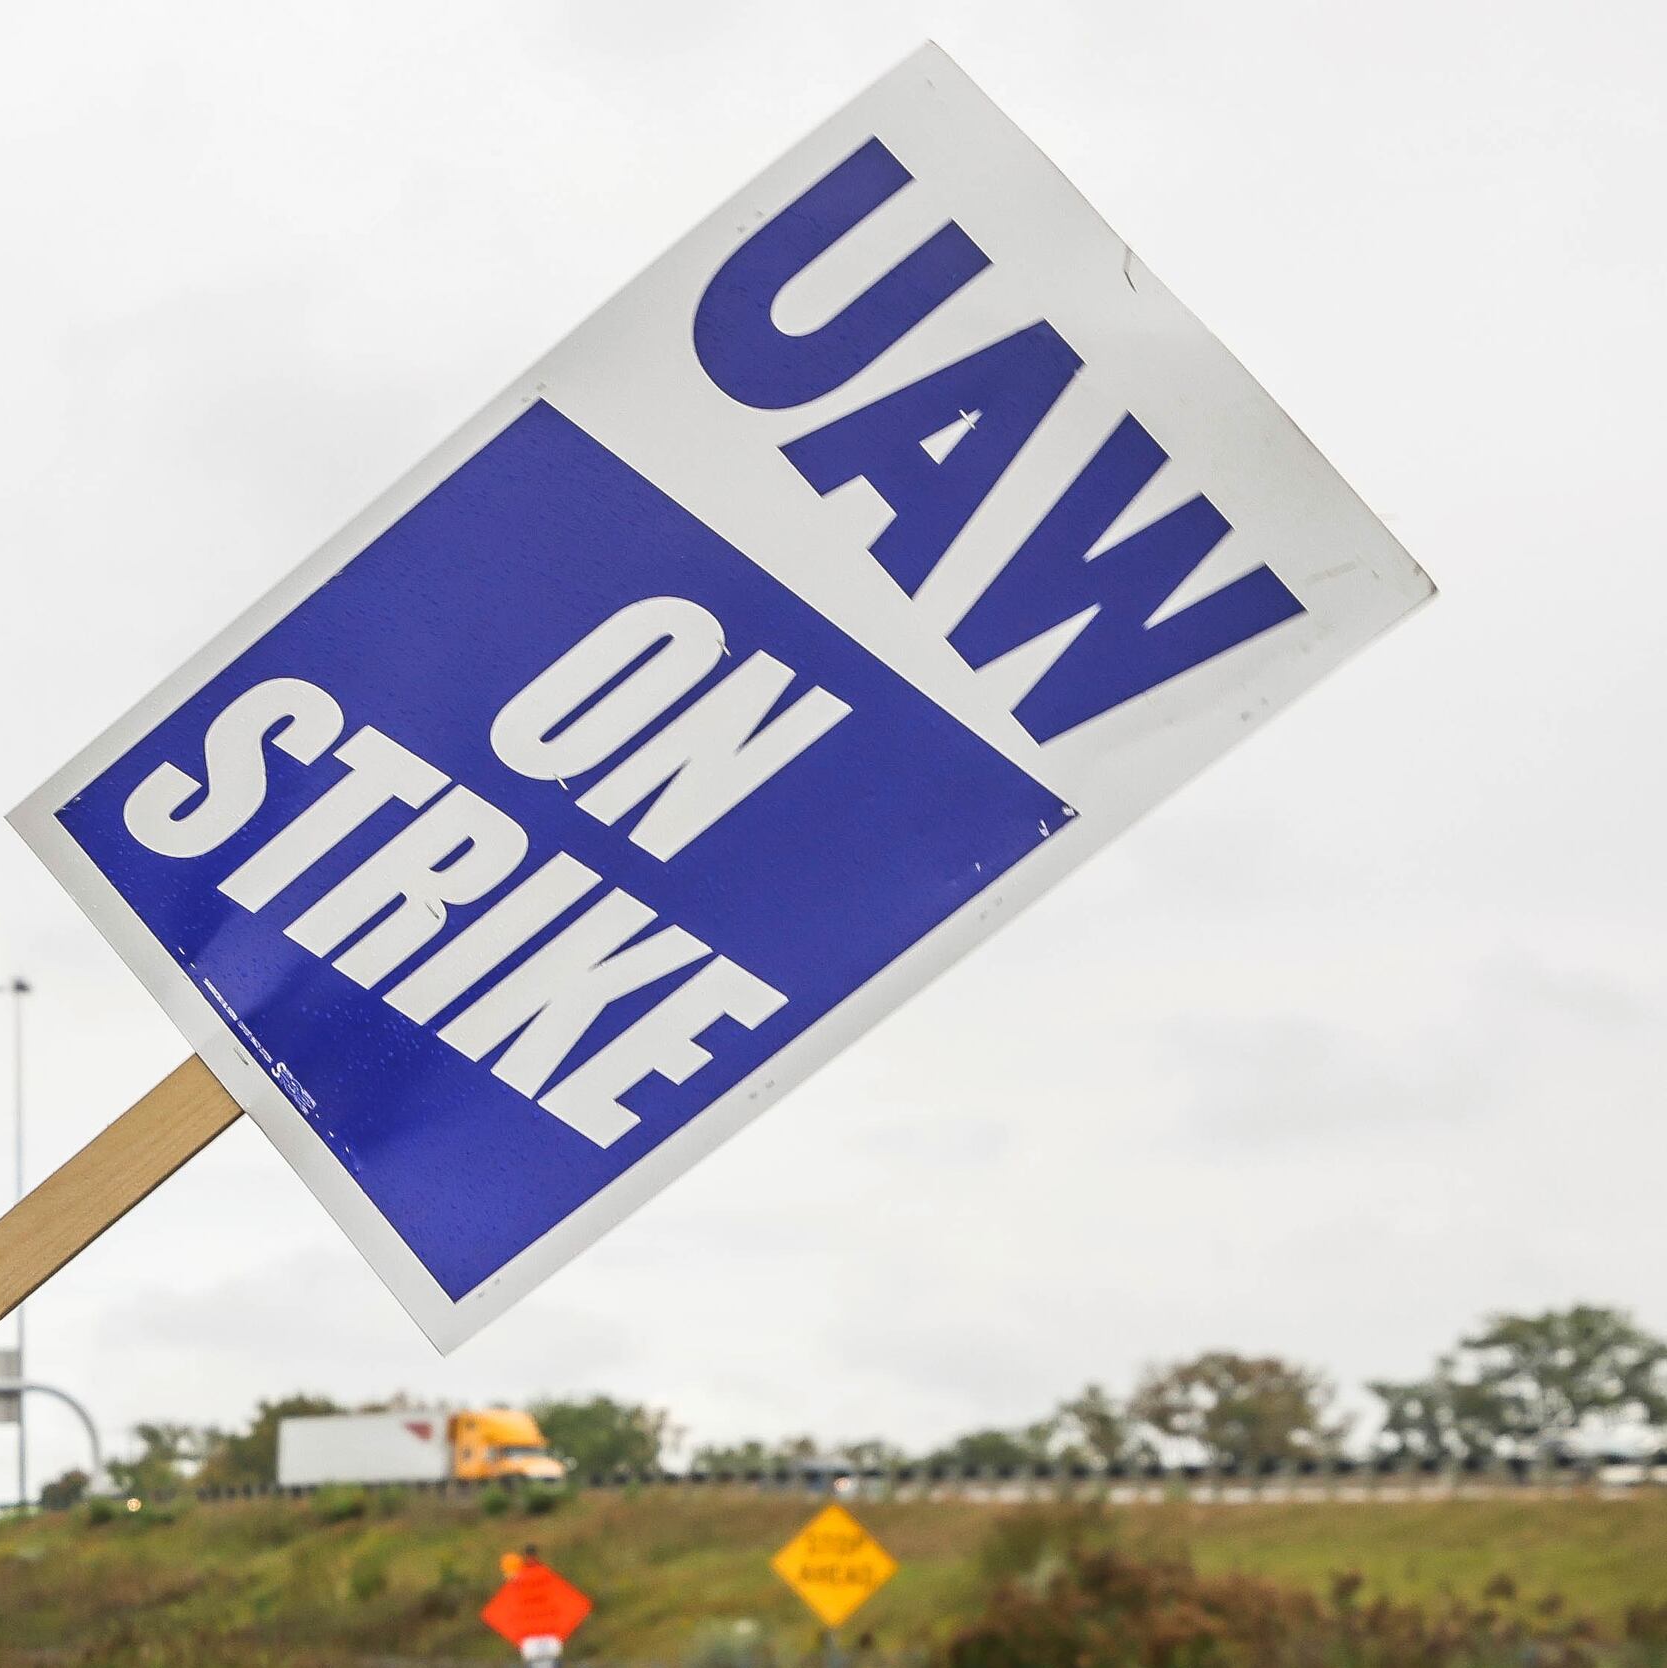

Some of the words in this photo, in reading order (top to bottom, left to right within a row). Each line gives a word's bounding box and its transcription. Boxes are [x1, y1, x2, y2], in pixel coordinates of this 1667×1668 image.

[692, 134, 1307, 746] UAW
[122, 676, 789, 1149] STRIKE
[489, 595, 853, 863] ON
